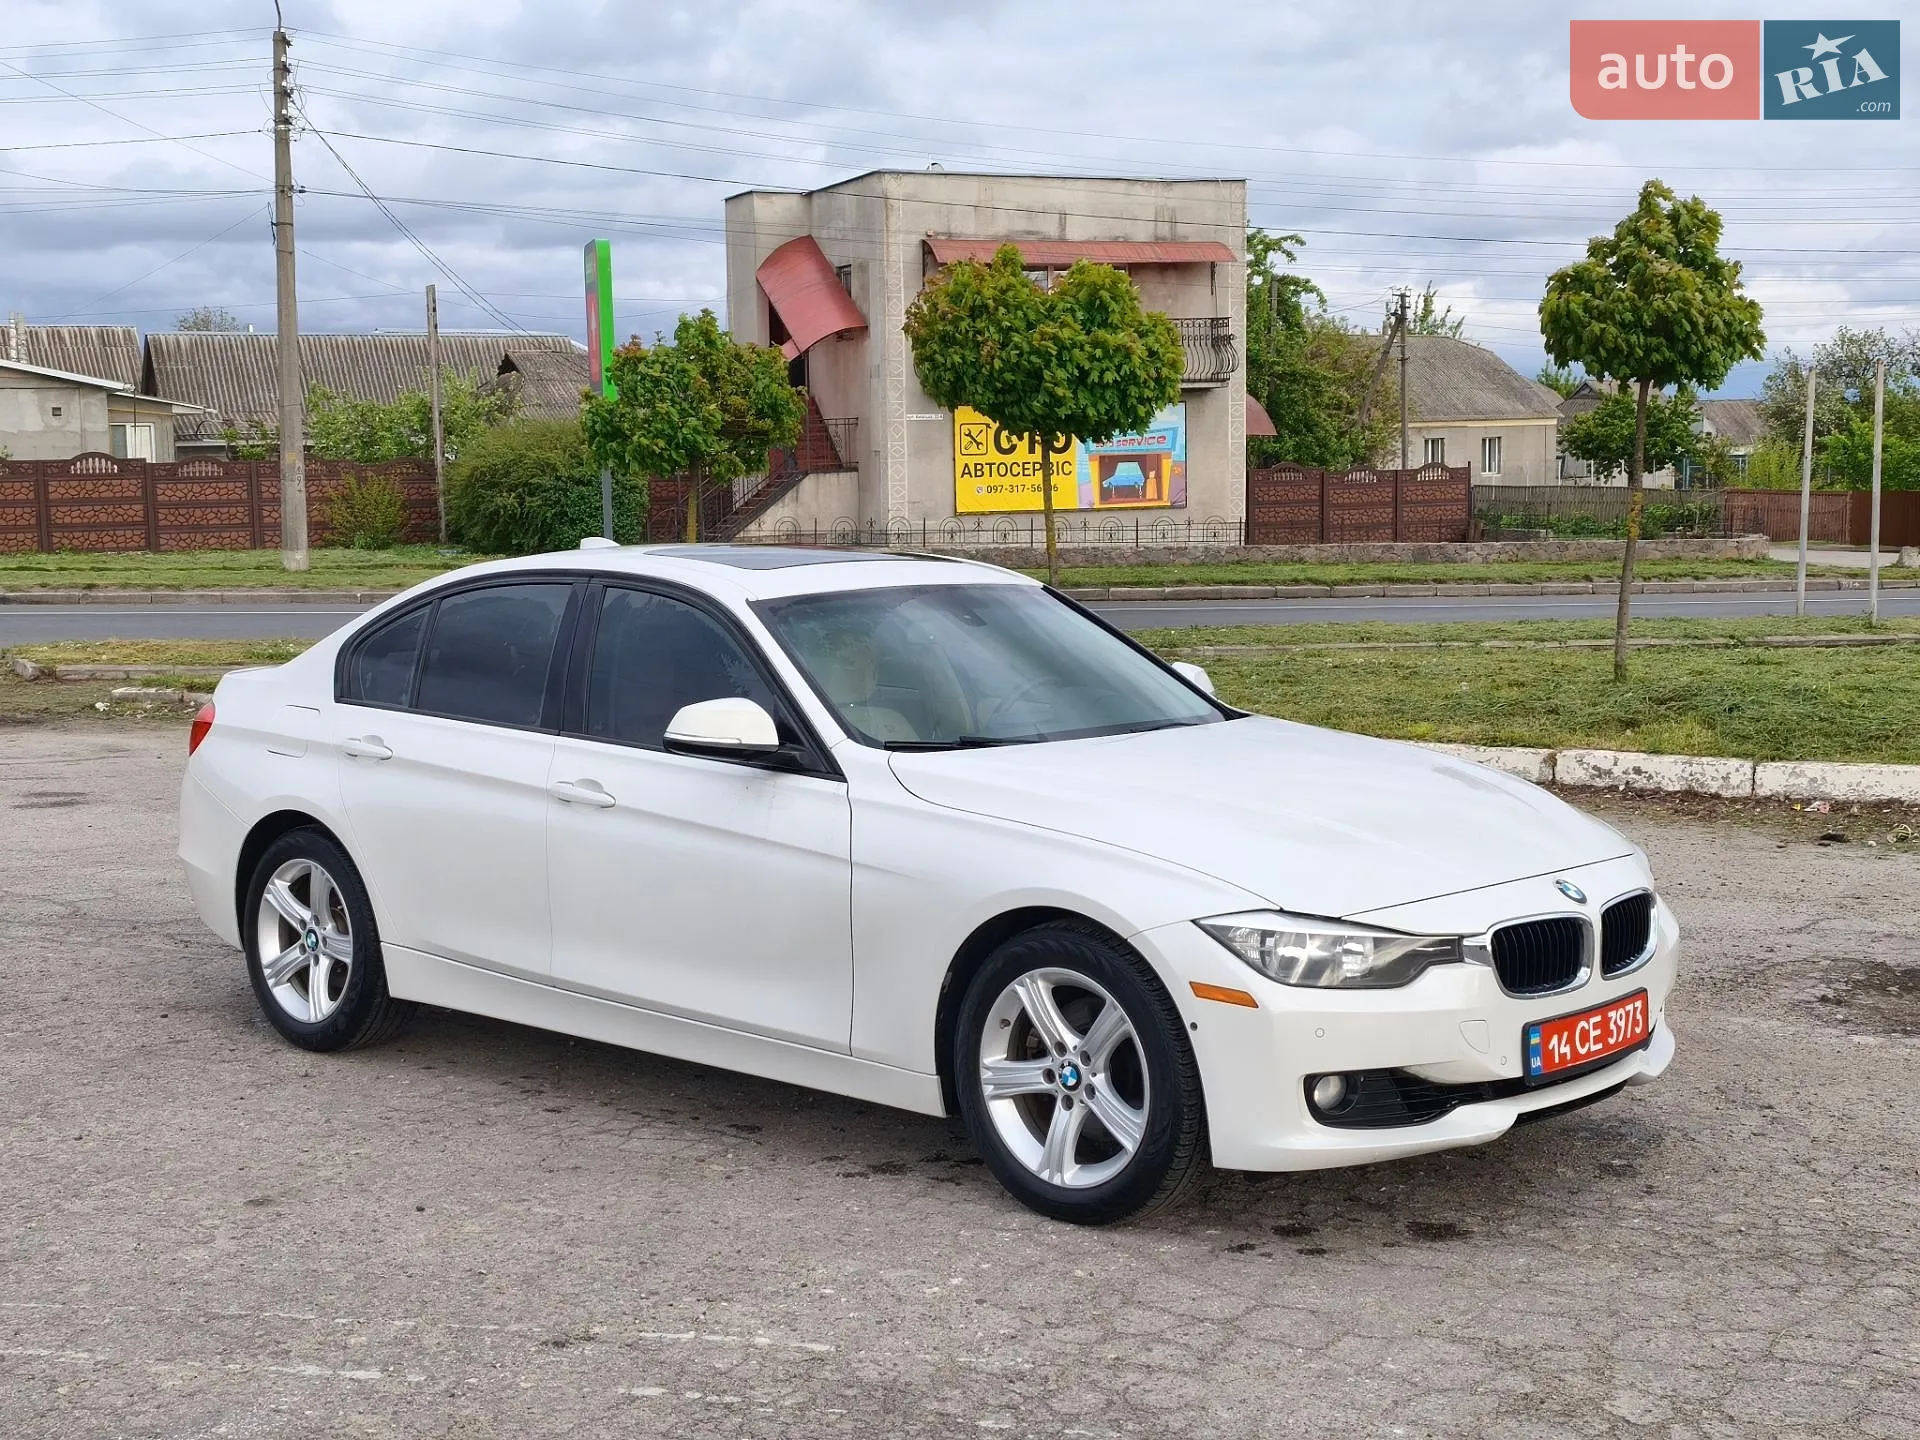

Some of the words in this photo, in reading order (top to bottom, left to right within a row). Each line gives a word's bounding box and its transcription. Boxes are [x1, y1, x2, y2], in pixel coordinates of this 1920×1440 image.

[986, 483, 1059, 494] 097-317-566
[1548, 1031, 1571, 1064] 14
[1575, 1015, 1603, 1055] CE
[1607, 1000, 1643, 1046] 3973
[1531, 1057, 1542, 1068] UA
